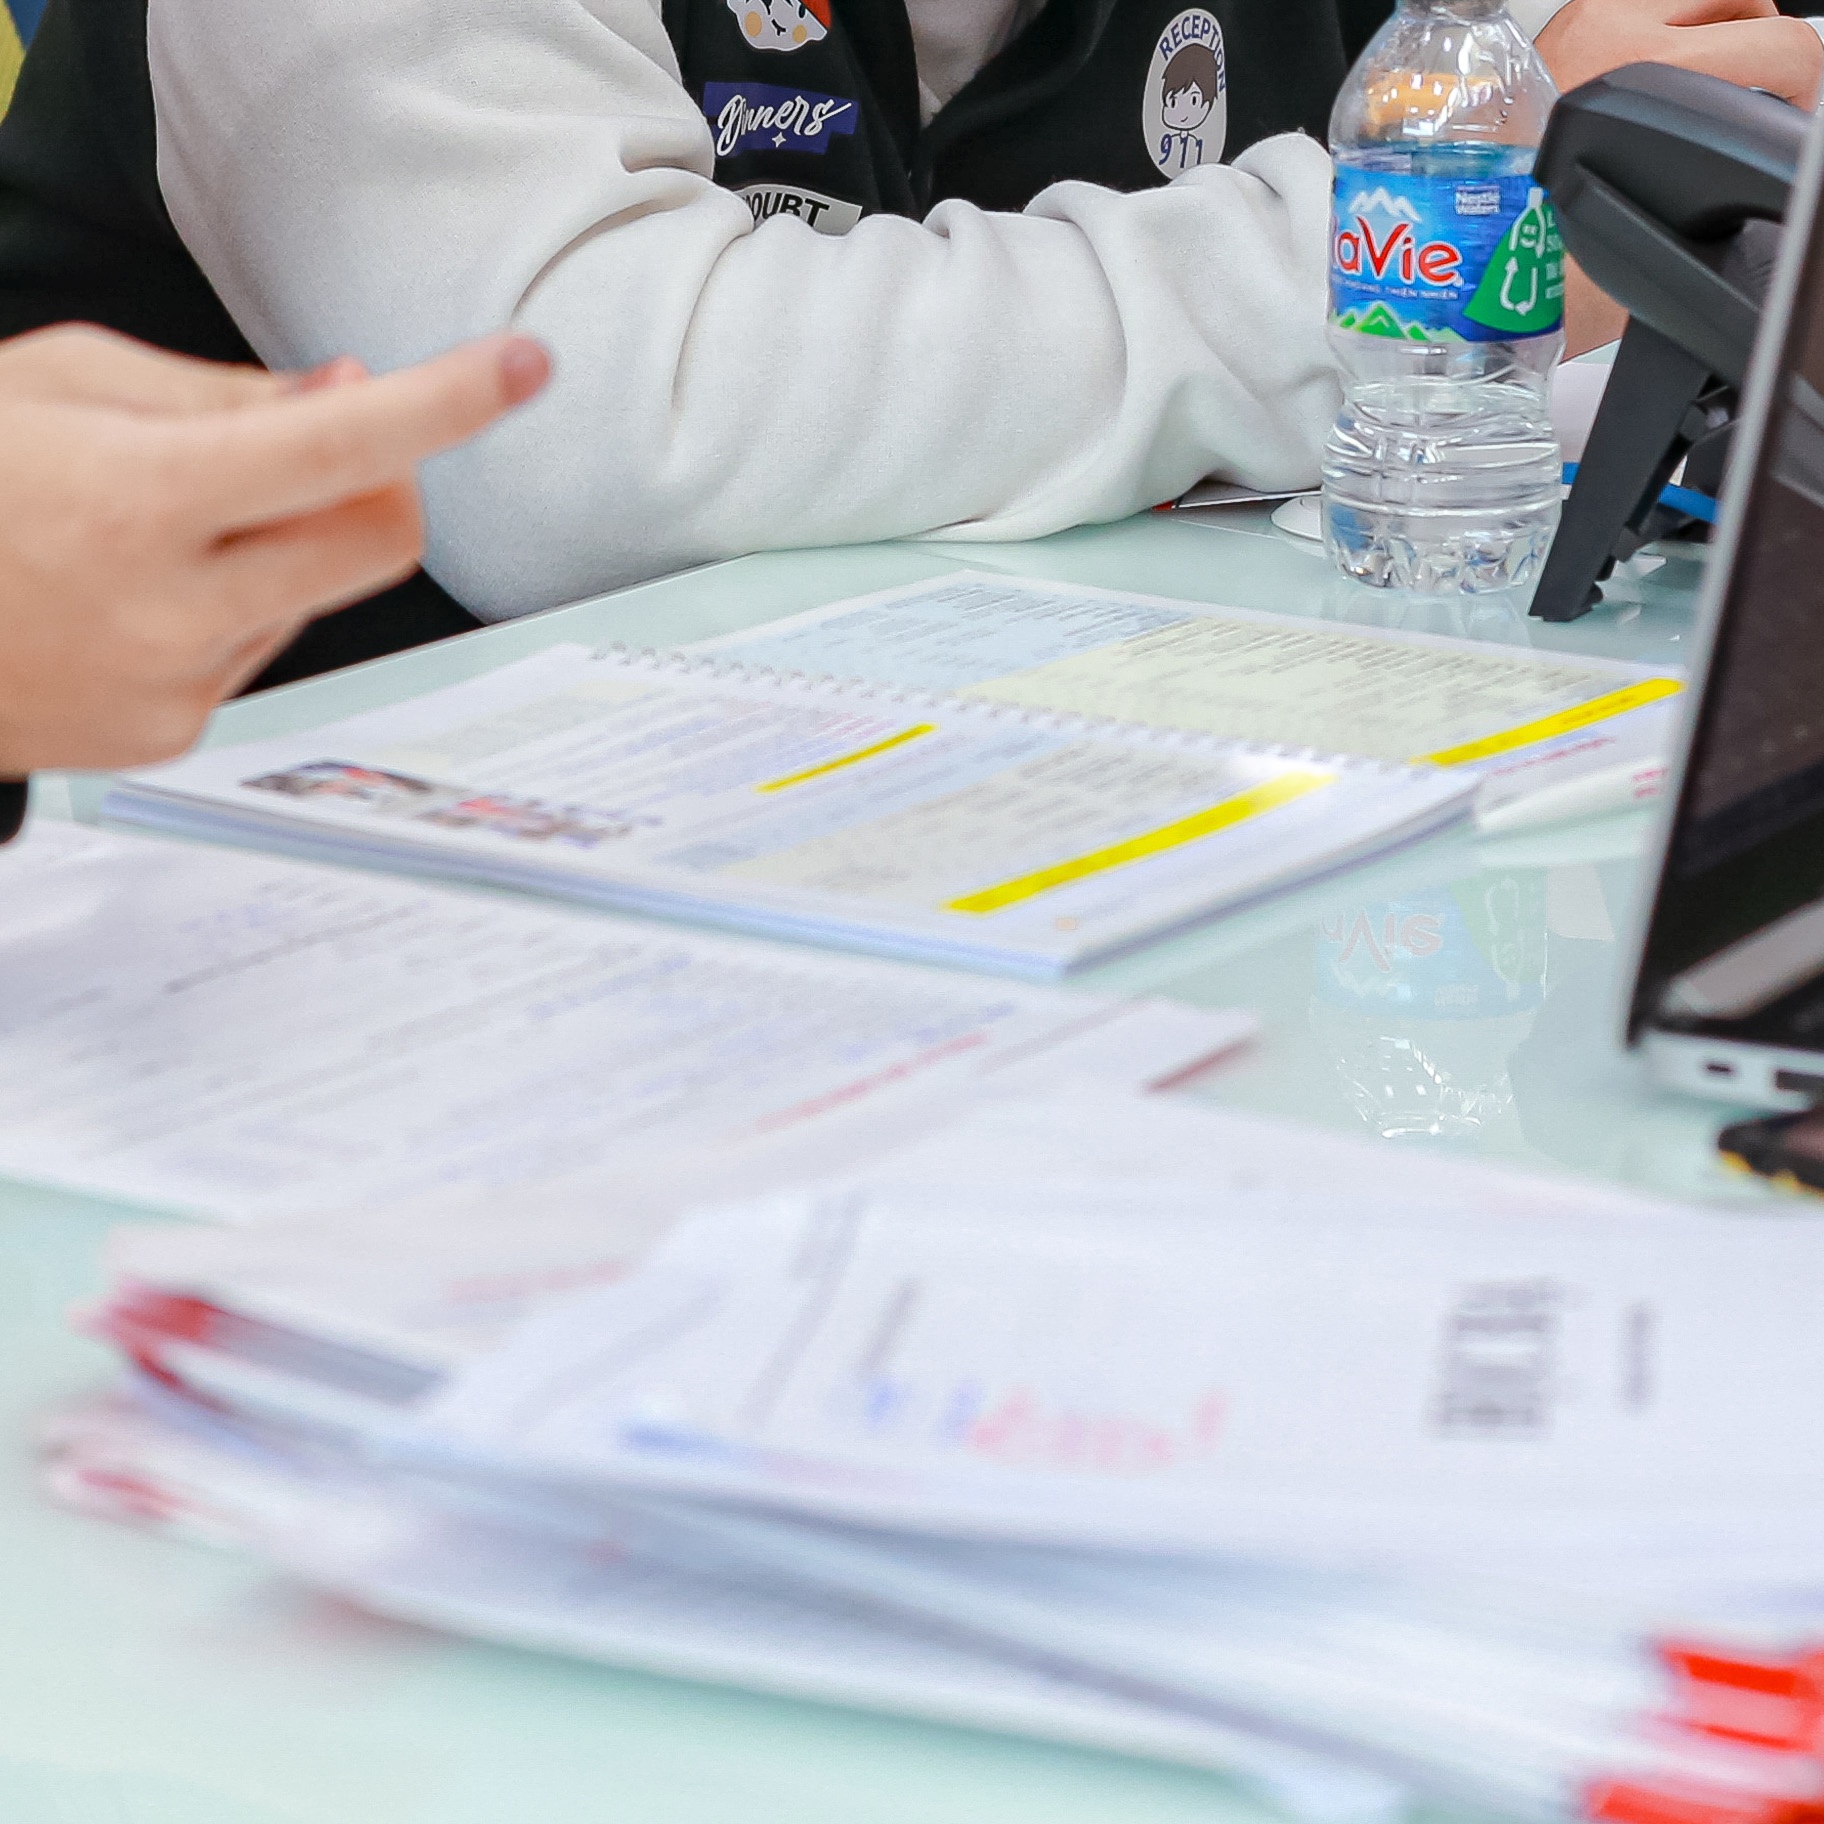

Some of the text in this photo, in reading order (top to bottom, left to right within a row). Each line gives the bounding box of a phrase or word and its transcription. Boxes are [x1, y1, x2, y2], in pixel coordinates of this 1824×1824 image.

[1159, 14, 1226, 93] RECEPTION
[1158, 133, 1203, 169] 911
[1330, 215, 1465, 286] aVie
